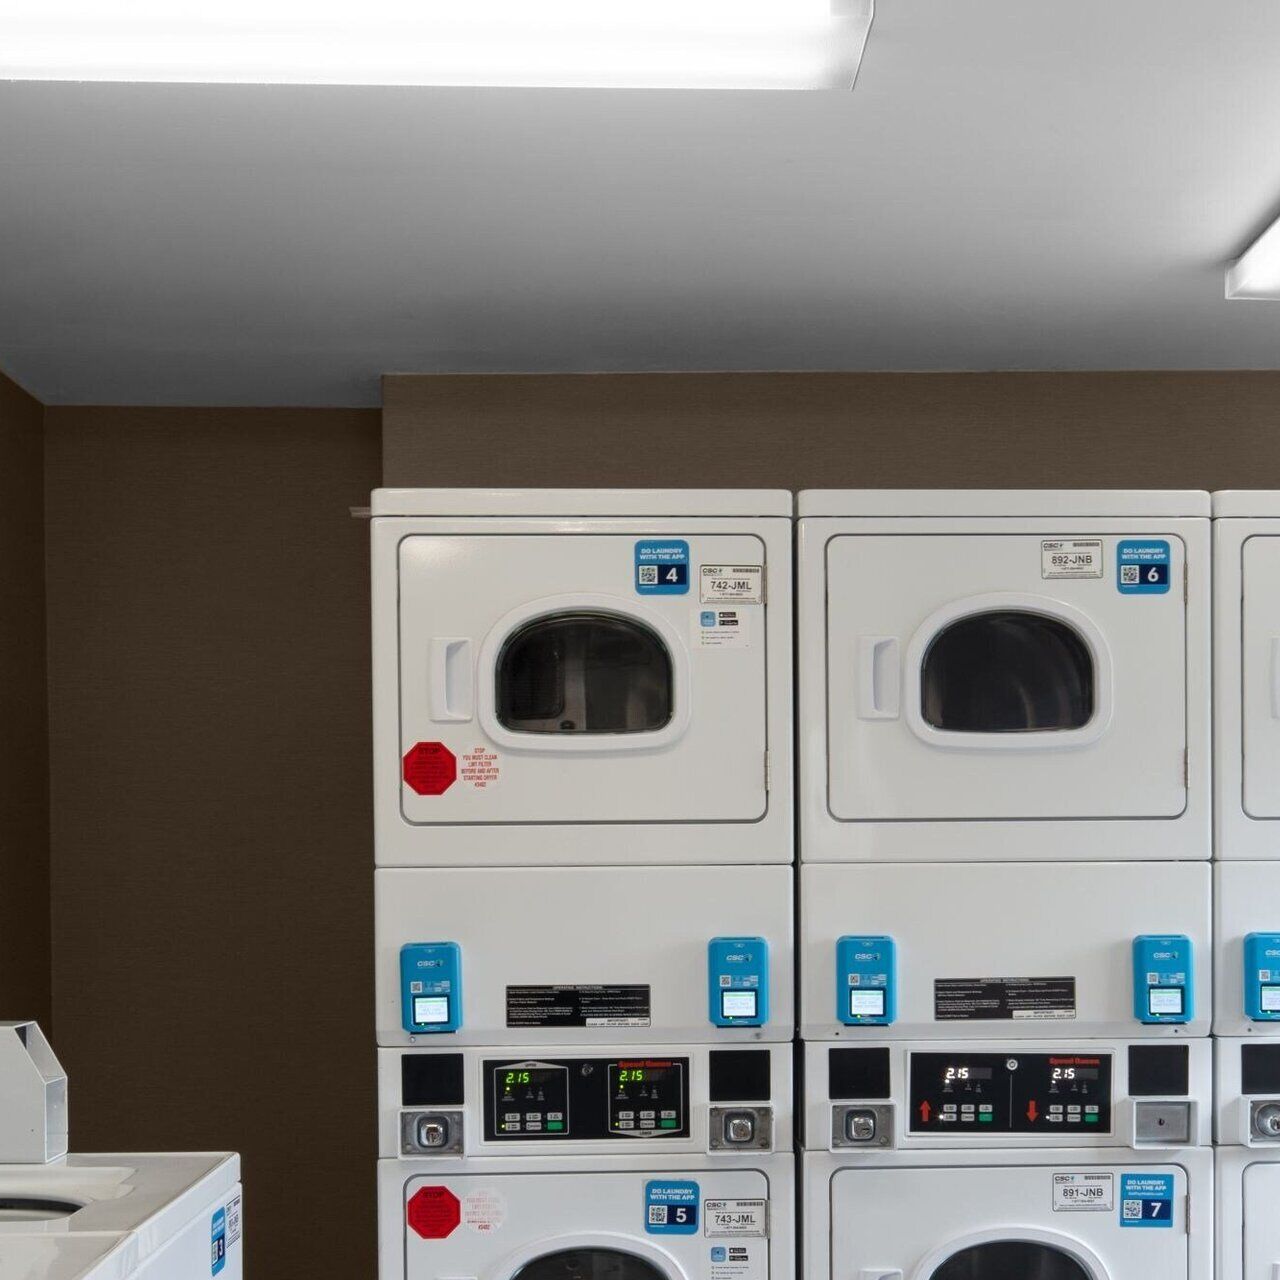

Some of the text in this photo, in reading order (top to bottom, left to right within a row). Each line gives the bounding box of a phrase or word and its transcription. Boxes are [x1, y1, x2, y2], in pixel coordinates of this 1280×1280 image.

[665, 567, 678, 582] 4
[1147, 567, 1159, 582] 6
[710, 581, 752, 590] 742-JML
[618, 1061, 645, 1069] Speed
[505, 1072, 530, 1084] 2.15
[619, 1070, 643, 1082] 2.15
[946, 1067, 969, 1079] 2.15
[1052, 1068, 1075, 1079] 2.15
[1062, 1188, 1104, 1197] 891-JNB
[675, 1208, 687, 1223] 5
[1151, 1203, 1162, 1217] 7
[715, 1214, 756, 1224] 743-JML
[218, 1238, 223, 1256] 3
